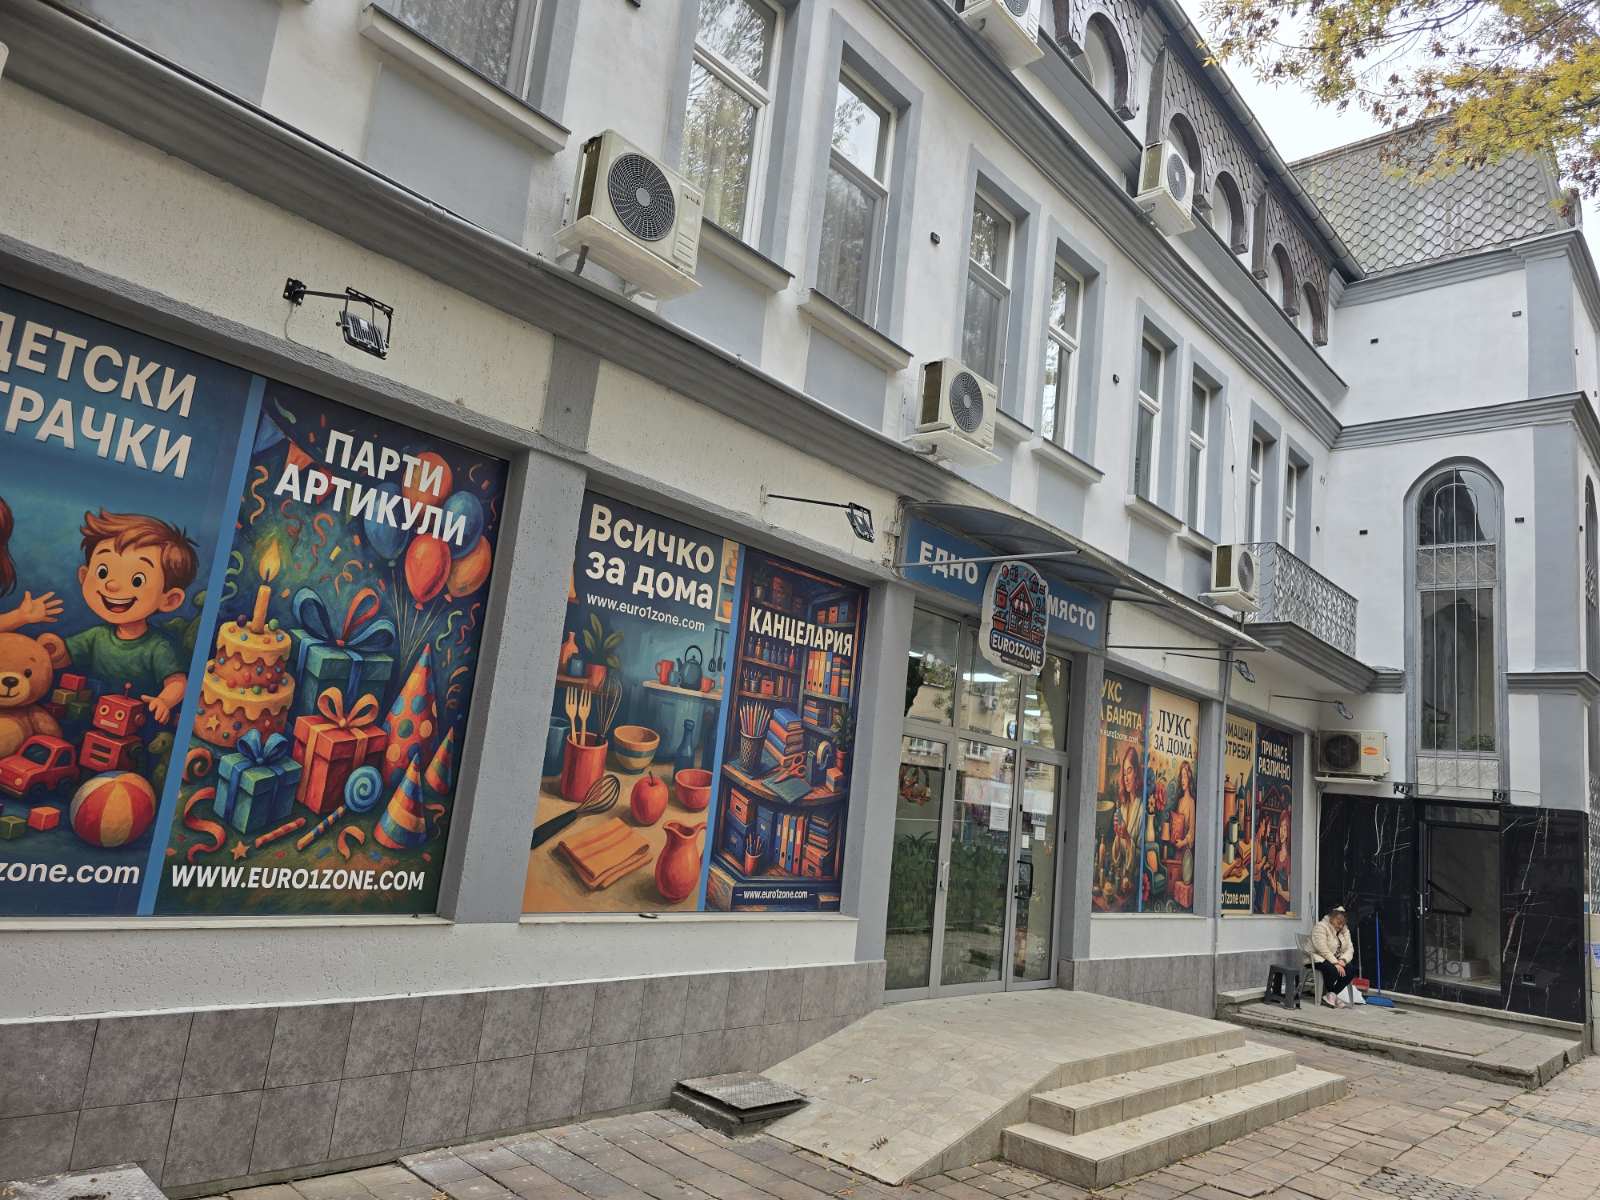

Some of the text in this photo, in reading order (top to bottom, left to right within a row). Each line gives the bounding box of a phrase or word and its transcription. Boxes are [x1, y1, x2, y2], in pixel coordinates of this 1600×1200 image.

[0, 381, 192, 479] РАЧКИ
[324, 429, 443, 497] ПАРТИ
[274, 464, 466, 546] АРТИКУЛИ
[919, 541, 1096, 631] ЕДНО МЯСТО
[587, 593, 705, 632] www.euro1zone.com
[750, 606, 853, 657] КАНЦЕЛАРИЯ
[992, 633, 1041, 665] EURO1ZONE
[1107, 705, 1143, 731] БАНЯТА
[1157, 709, 1192, 740] ЛУКС
[1154, 735, 1193, 759] ЗА ДОМА
[1258, 757, 1291, 781] РАЗЛИЧНО
[171, 865, 425, 891] WWW.EURO1ZONE.COM
